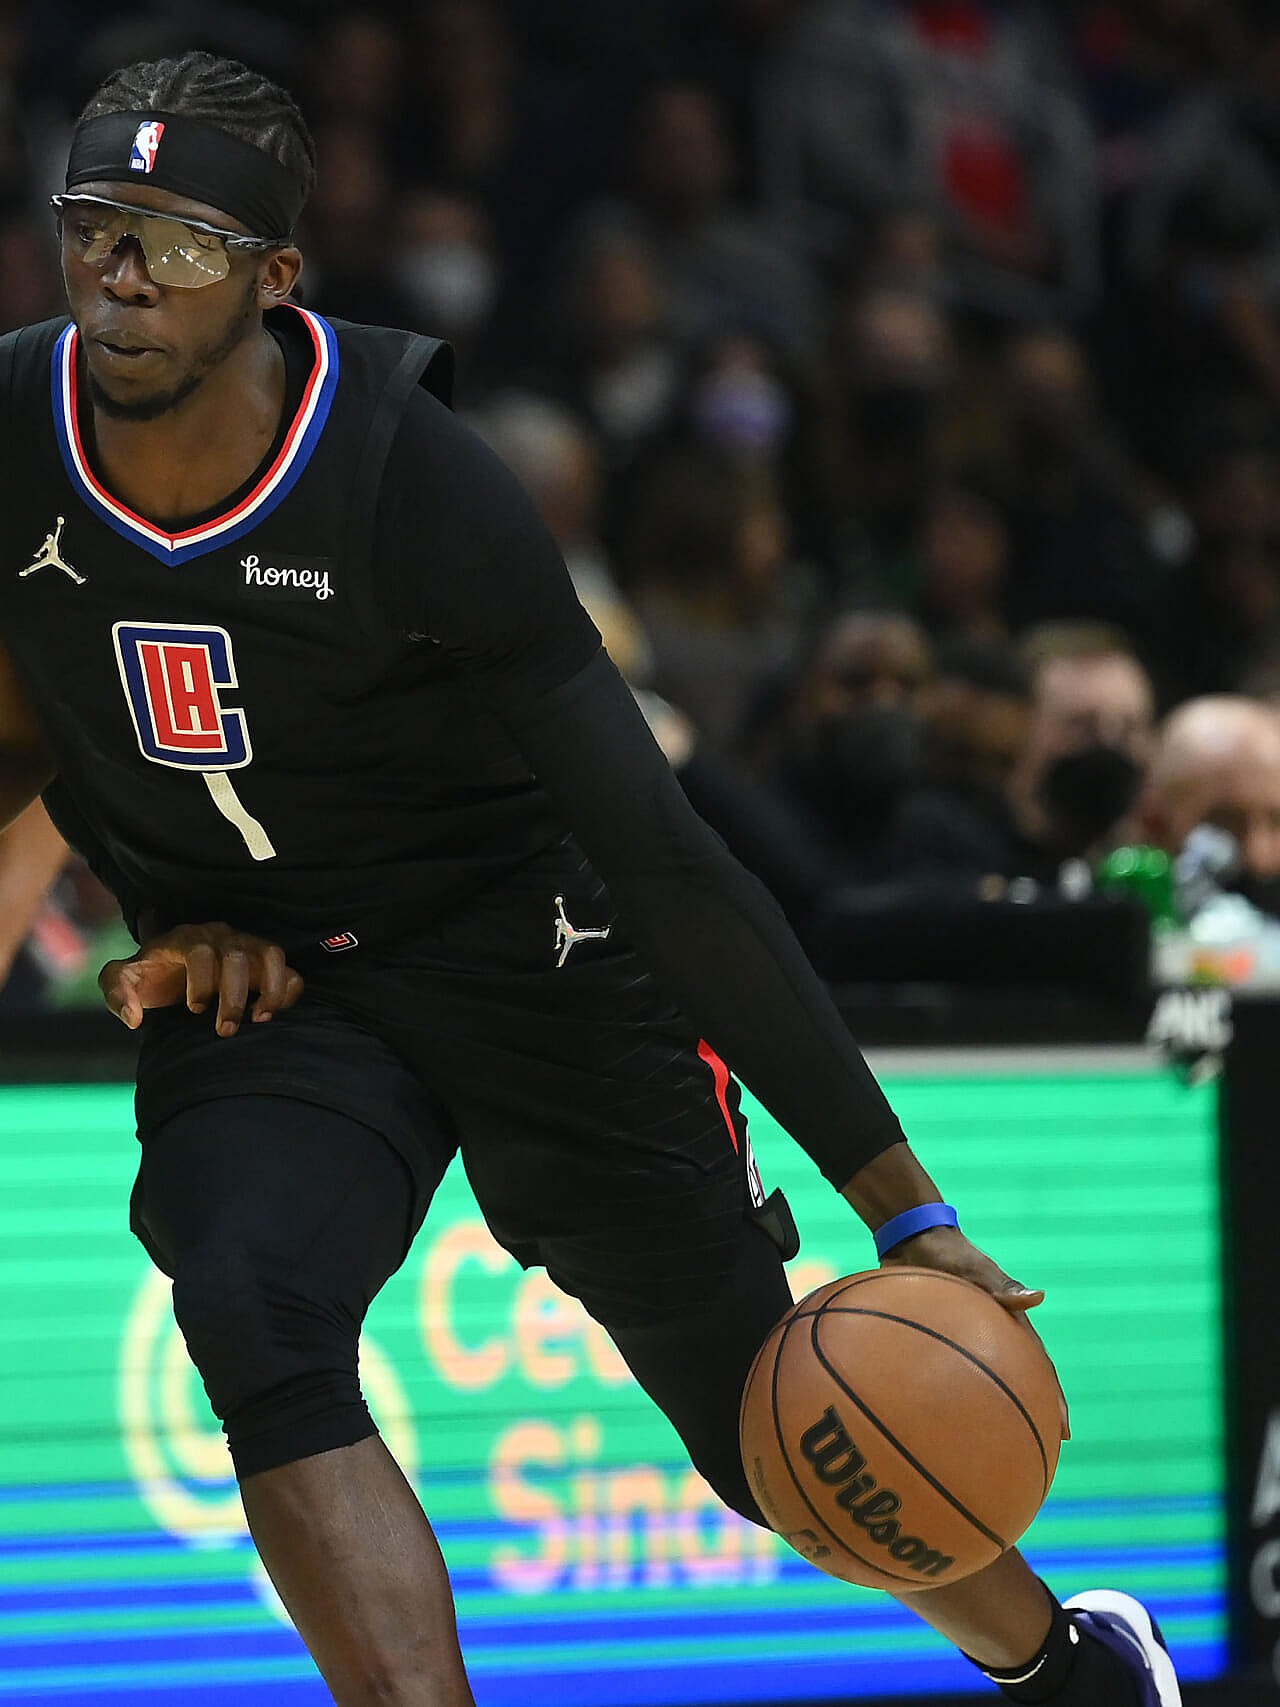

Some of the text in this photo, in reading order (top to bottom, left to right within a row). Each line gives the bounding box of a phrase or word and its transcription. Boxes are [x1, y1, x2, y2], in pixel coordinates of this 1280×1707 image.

[240, 555, 335, 600] honey
[202, 772, 277, 861] 1
[799, 1403, 957, 1578] Wilson
